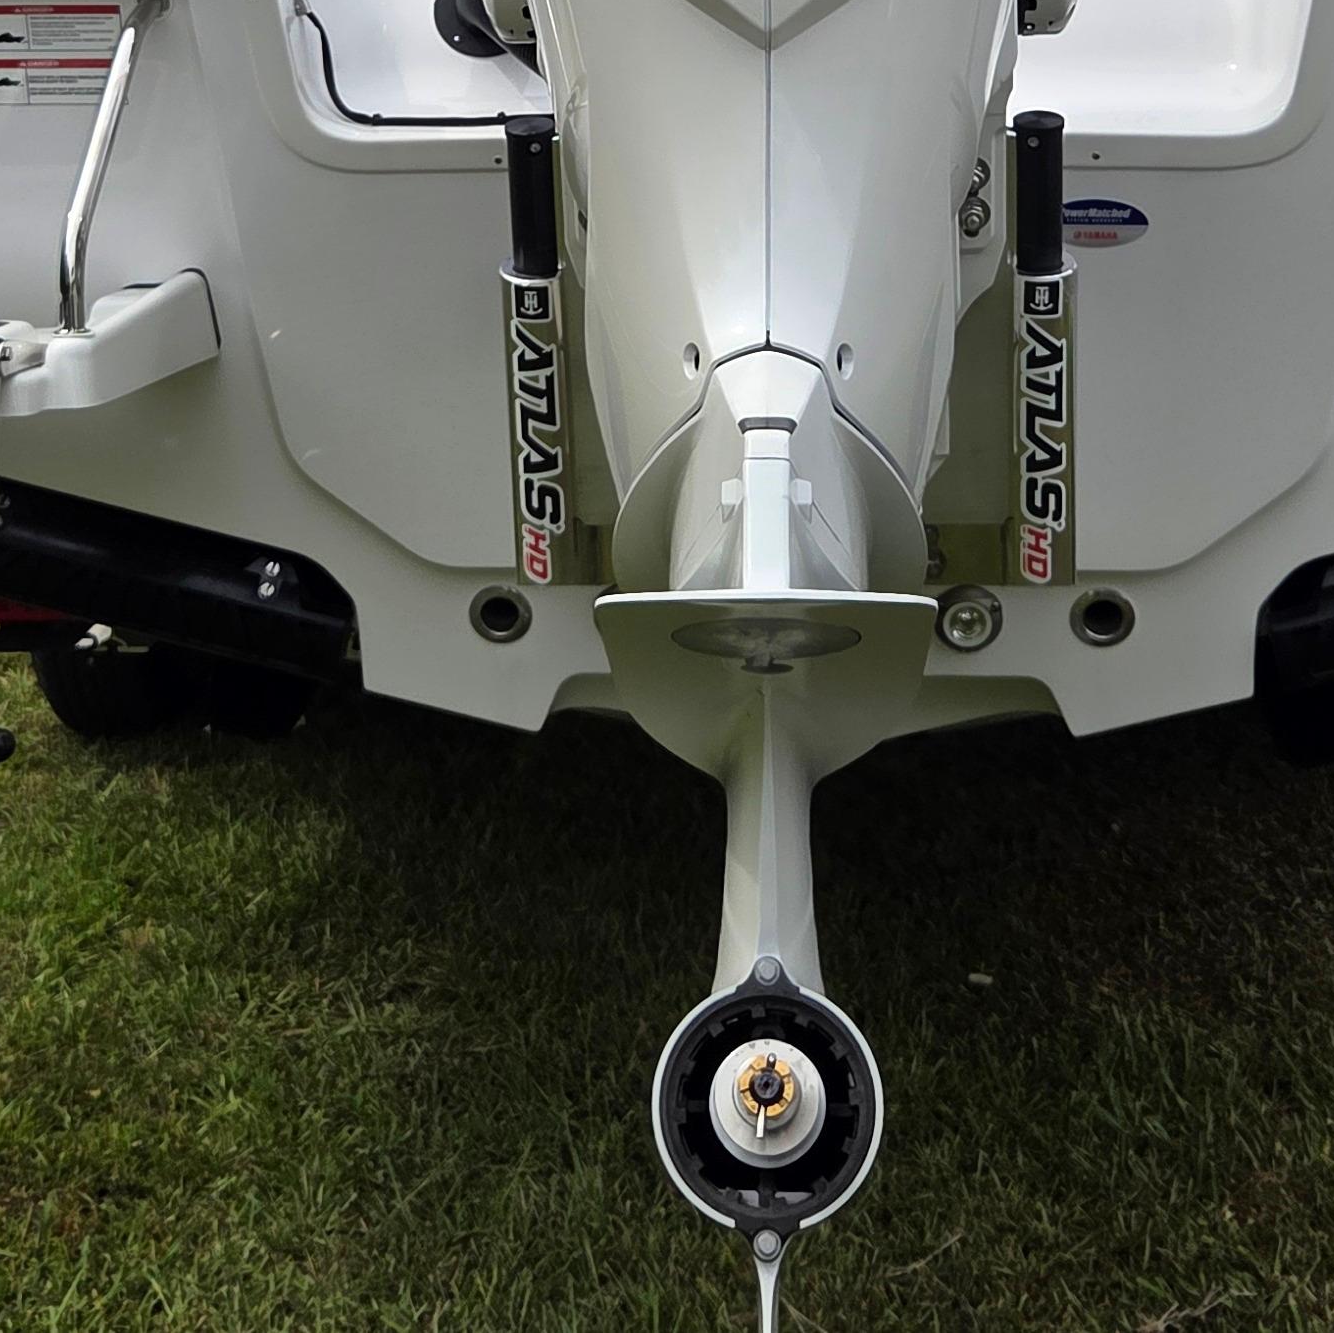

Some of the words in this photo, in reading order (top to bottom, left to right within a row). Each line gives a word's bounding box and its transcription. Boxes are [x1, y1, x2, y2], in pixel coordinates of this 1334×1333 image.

[512, 318, 564, 528] ATLAS
[1021, 316, 1066, 526] ATLAS
[523, 526, 549, 581] HD
[1022, 526, 1049, 580] HD
